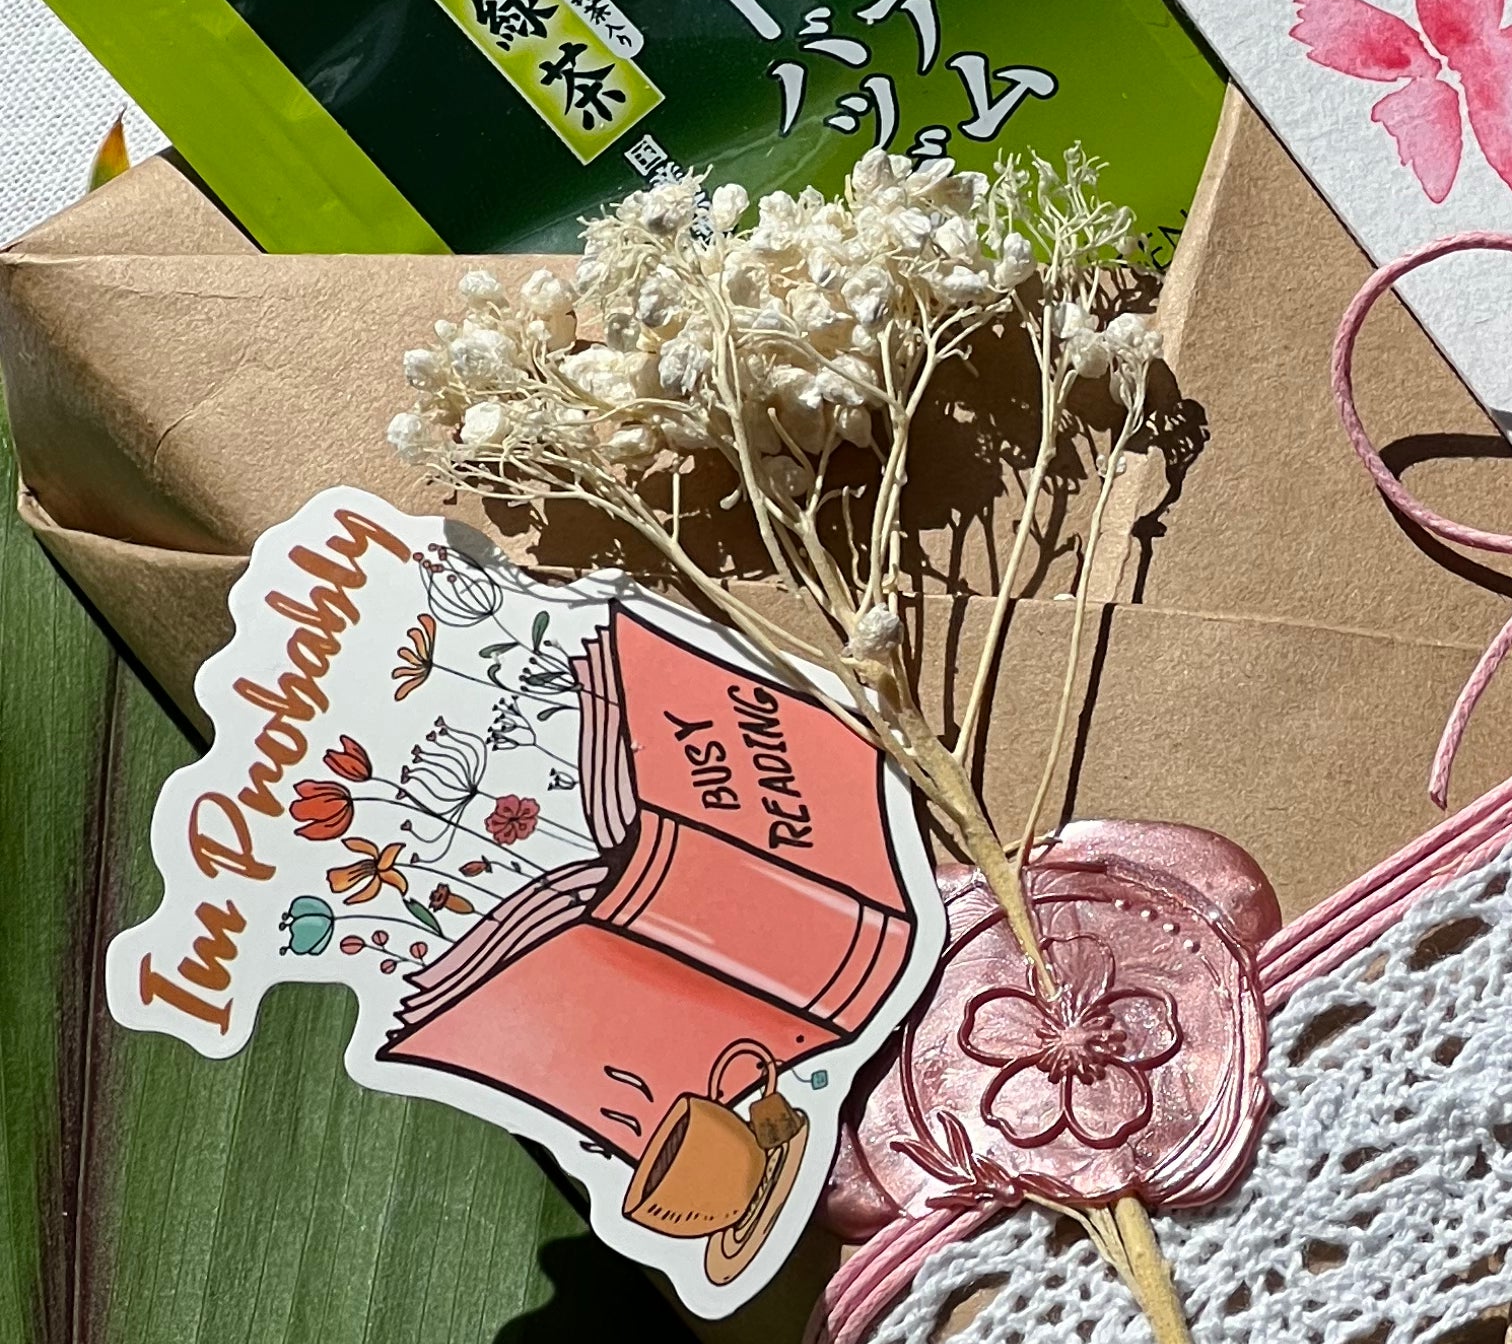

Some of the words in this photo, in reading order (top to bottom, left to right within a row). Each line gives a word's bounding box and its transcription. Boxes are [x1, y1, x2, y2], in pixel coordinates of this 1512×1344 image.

[189, 508, 412, 882] Probably
[663, 710, 741, 810] BUSY
[727, 684, 814, 849] READING
[139, 898, 247, 1036] Im
